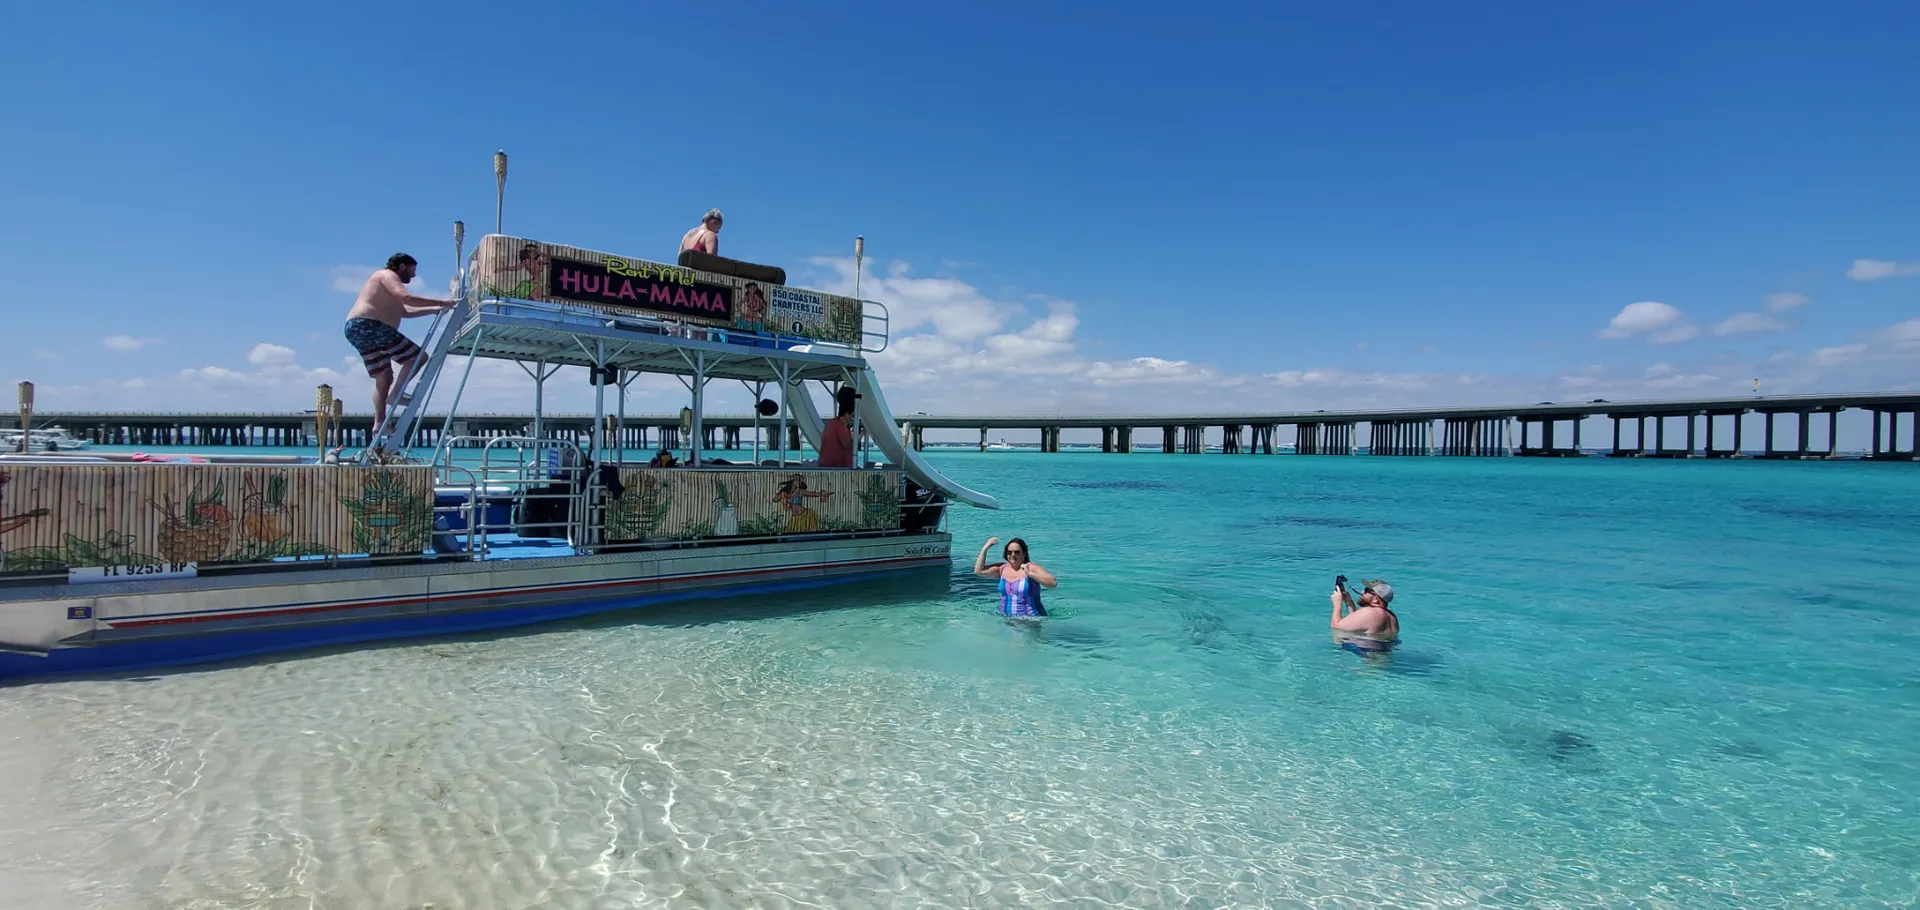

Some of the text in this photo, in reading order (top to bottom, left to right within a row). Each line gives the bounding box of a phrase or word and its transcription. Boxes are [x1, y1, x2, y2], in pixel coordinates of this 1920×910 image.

[603, 258, 696, 287] Rent Me!
[559, 267, 726, 312] HULA-MAMA
[772, 289, 820, 304] 850 COASTAL
[772, 299, 824, 314] CHARTERS LLC
[103, 565, 119, 577] FL
[126, 563, 163, 576] 9253
